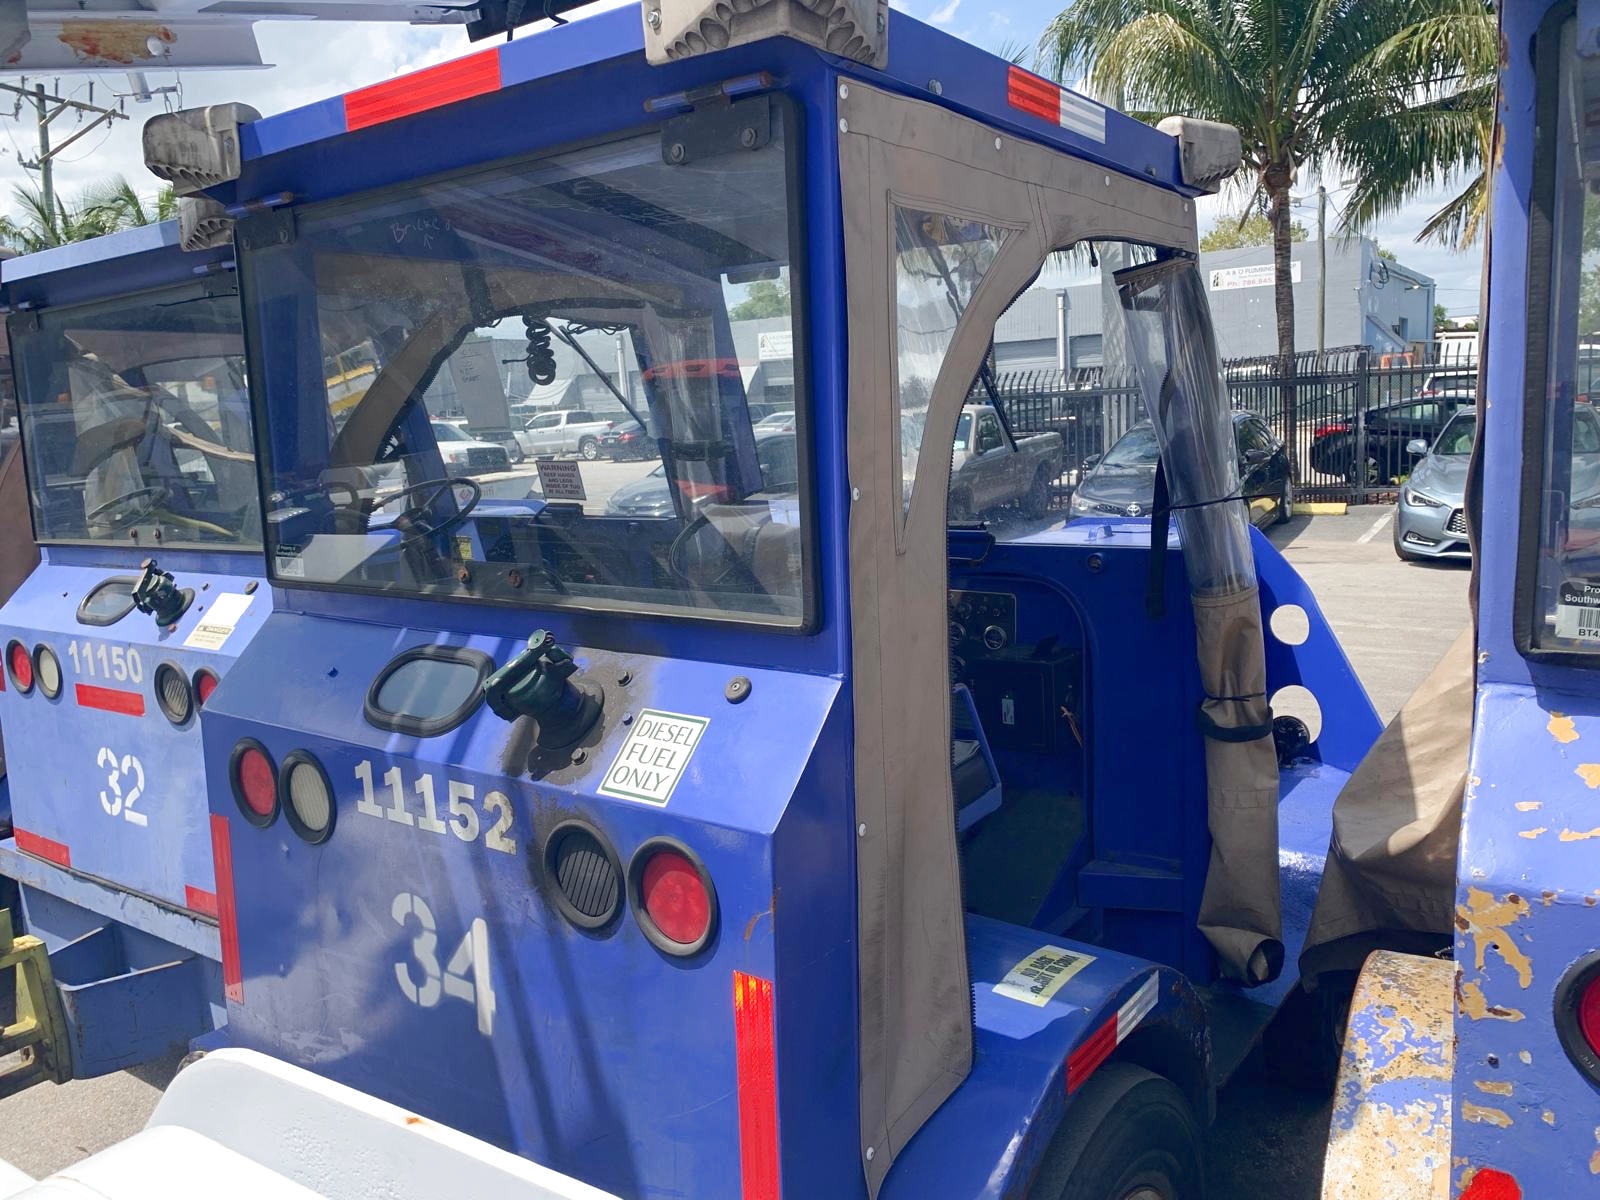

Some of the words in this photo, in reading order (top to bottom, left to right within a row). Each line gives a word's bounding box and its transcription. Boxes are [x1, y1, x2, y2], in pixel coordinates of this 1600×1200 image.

[1245, 266, 1275, 274] PLUMBING
[540, 464, 577, 472] WARNING
[1578, 628, 1600, 637] BT4
[68, 640, 143, 684] 11150
[636, 719, 694, 747] DIESEL
[625, 742, 677, 771] FUEL
[97, 747, 148, 827] 32
[612, 765, 671, 792] ONLY
[354, 759, 517, 856] 11152
[391, 892, 496, 1036] 34
